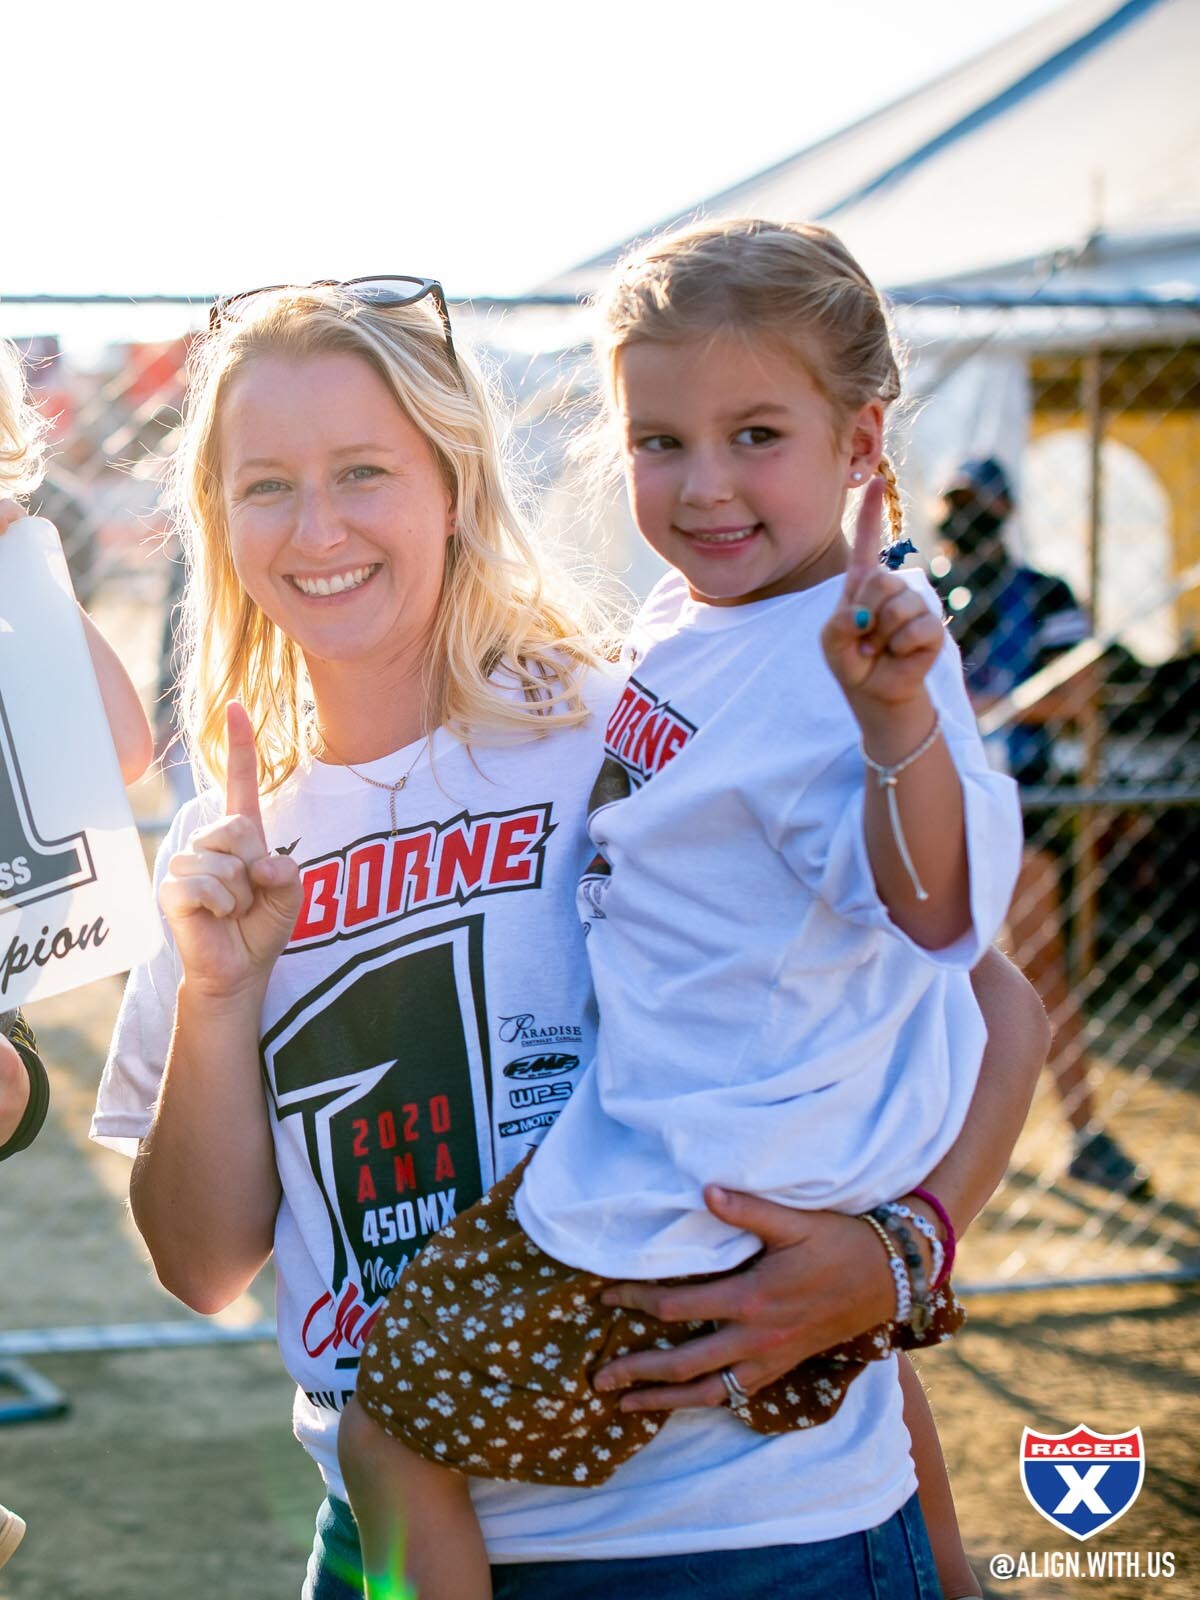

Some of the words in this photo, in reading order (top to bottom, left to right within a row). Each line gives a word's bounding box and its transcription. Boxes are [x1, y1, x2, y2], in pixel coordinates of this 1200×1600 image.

[288, 813, 541, 944] BORNE
[352, 1094, 452, 1158] 2020
[509, 1081, 573, 1109] WPS
[362, 1188, 457, 1248] 450MX
